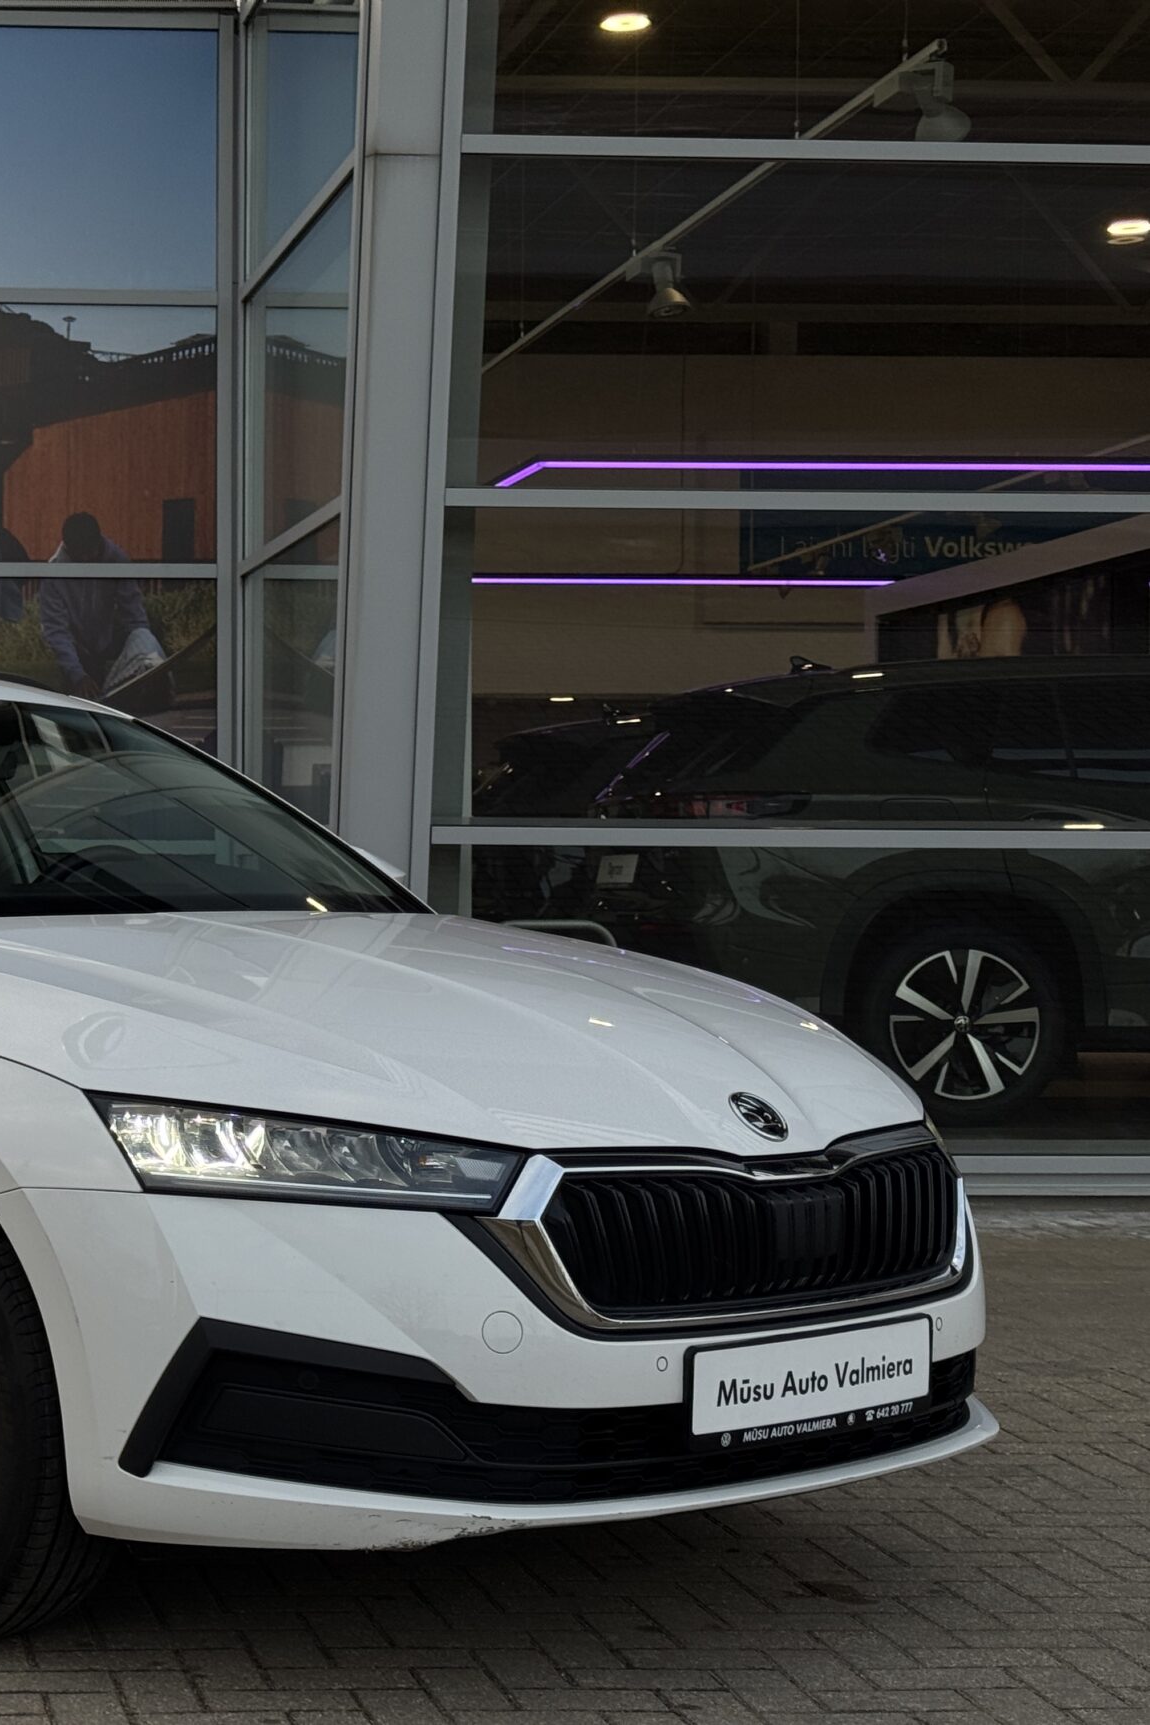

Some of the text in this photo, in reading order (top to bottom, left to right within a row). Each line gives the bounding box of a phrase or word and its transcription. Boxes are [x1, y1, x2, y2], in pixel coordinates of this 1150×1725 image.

[716, 1355, 914, 1408] Mūsu Auto Valmiera
[876, 1401, 914, 1419] 642 20 777
[742, 1417, 838, 1443] MŪSU AUTO VALMIERA
